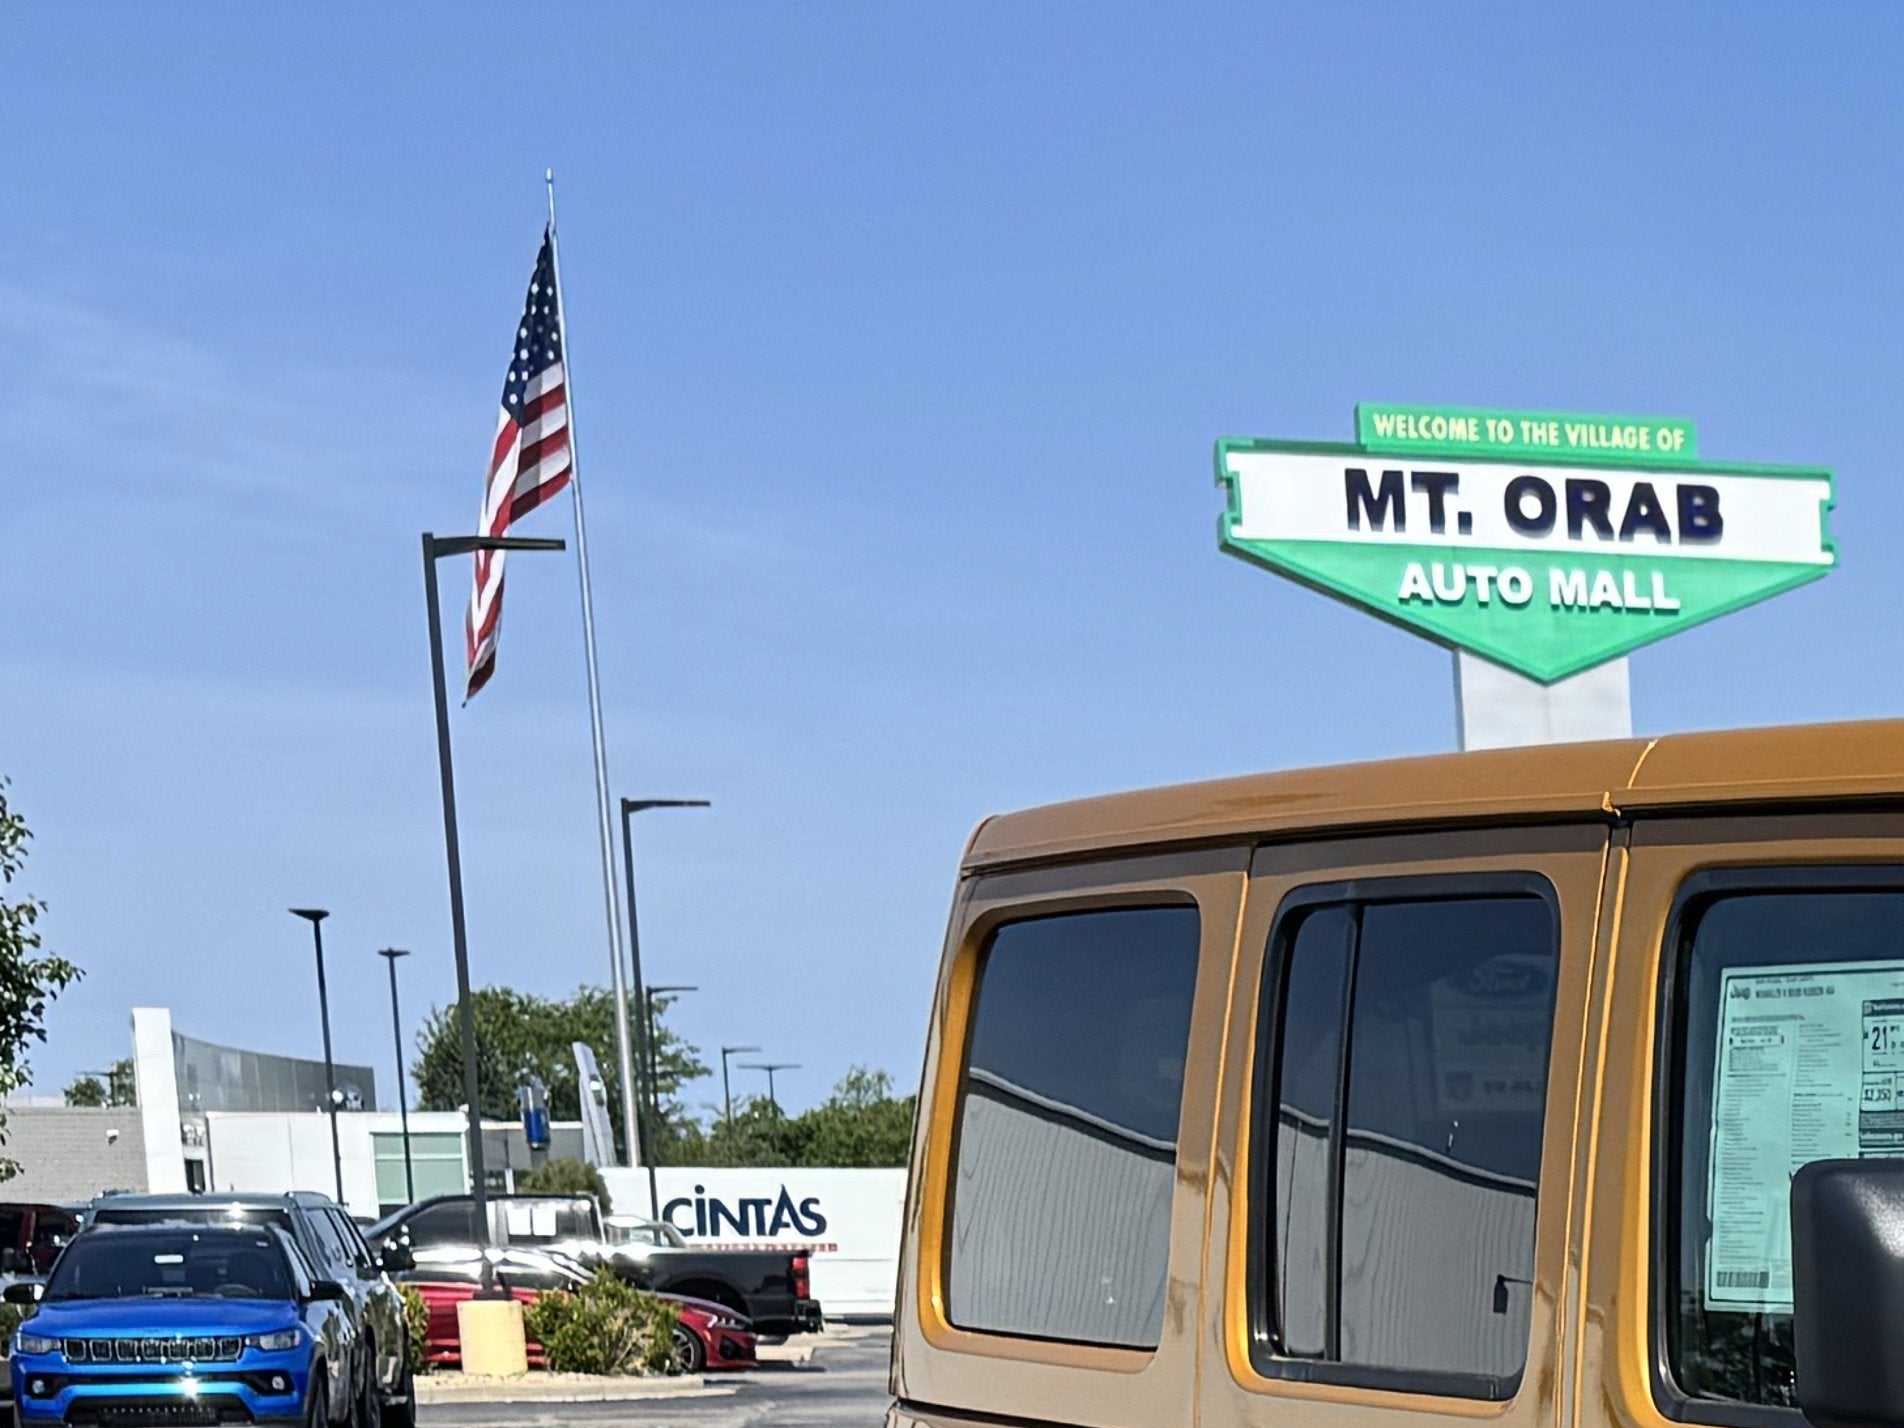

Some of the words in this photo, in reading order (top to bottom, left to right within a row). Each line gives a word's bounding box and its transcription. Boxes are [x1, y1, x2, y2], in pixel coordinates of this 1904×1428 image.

[1373, 412, 1479, 443] WELCOME
[1487, 418, 1514, 445] TO
[1520, 420, 1560, 446] THE
[1564, 422, 1650, 451] VILLAGE
[1656, 427, 1686, 452] OF
[1344, 468, 1474, 535] MT.
[1503, 475, 1725, 545] ORAB
[1398, 562, 1534, 606] AUTO
[1548, 568, 1681, 612] MALL
